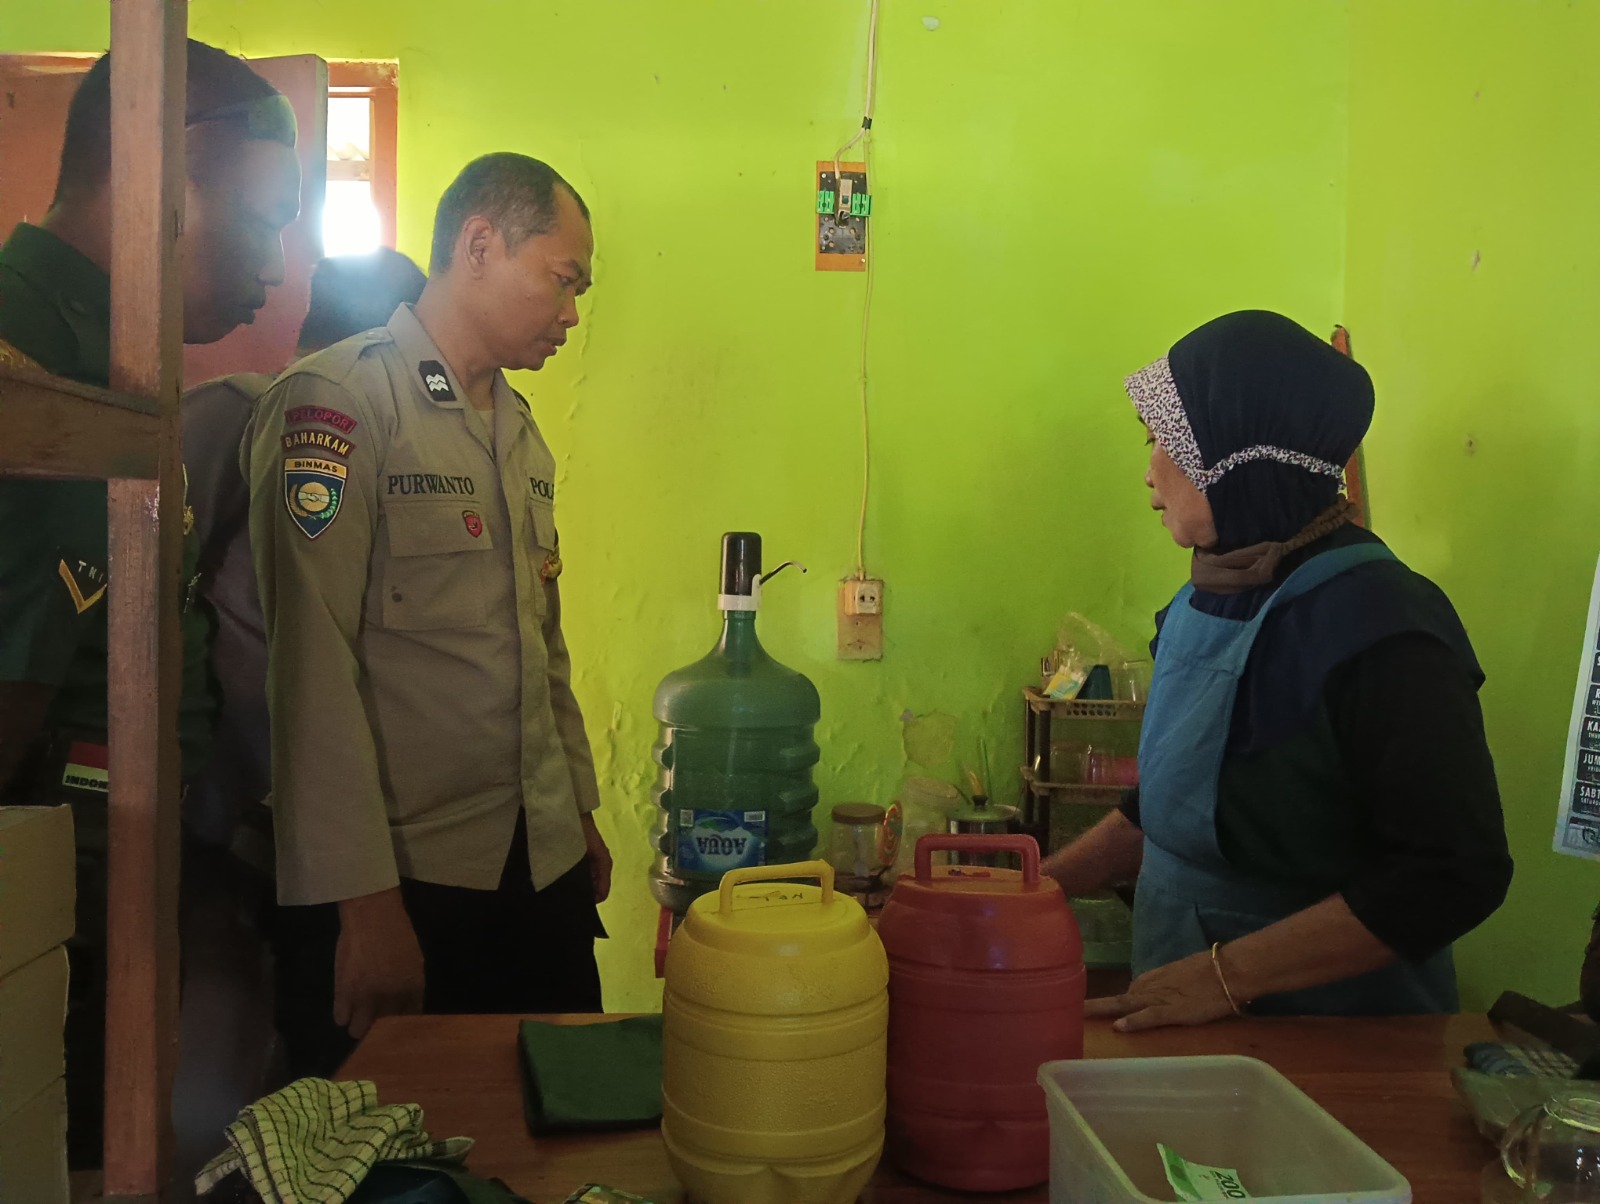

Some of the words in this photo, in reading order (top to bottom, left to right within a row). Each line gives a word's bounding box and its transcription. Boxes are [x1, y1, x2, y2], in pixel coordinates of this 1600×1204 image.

[285, 431, 350, 456] BAHARKAM
[294, 461, 338, 473] BINMAS
[387, 474, 475, 496] PURWANTO
[78, 559, 105, 583] TNI
[696, 834, 747, 856] AQUA
[1214, 1170, 1246, 1199] 200
